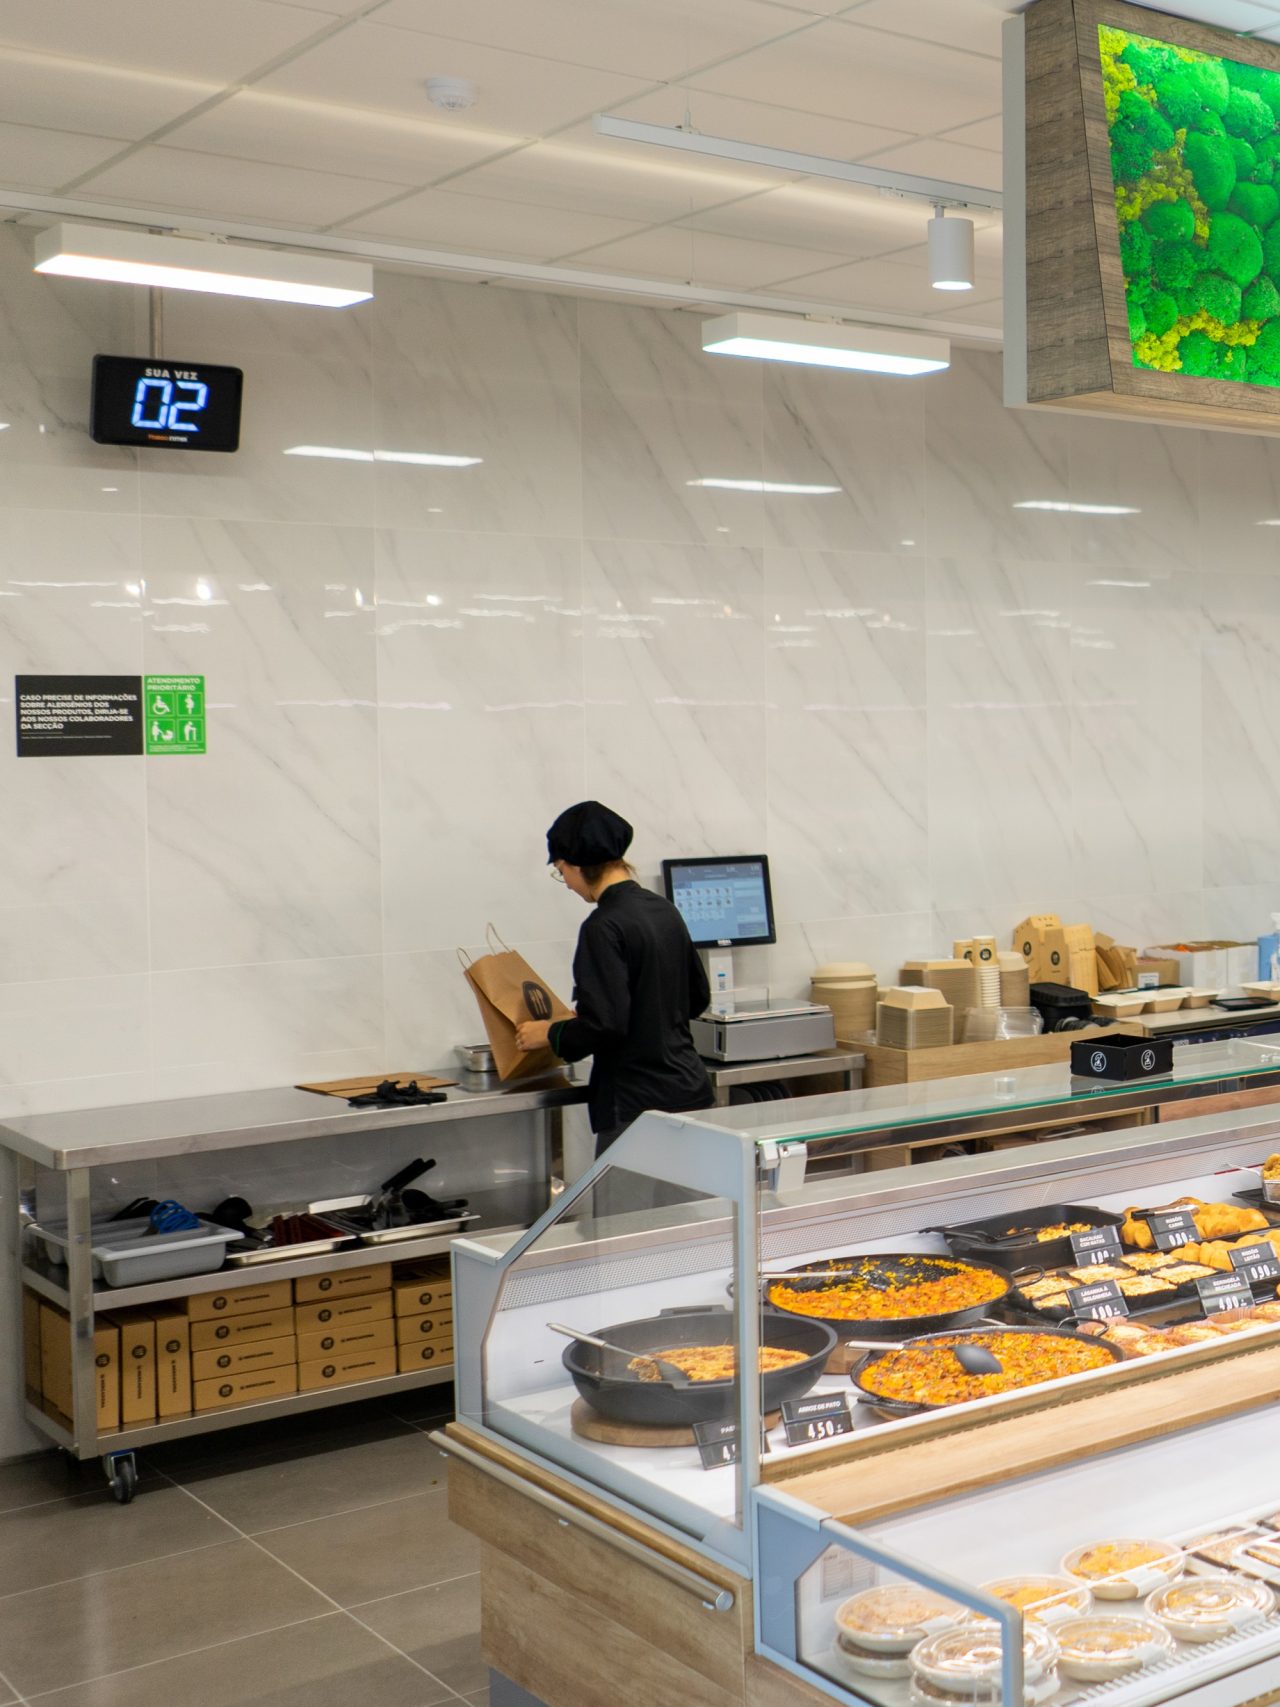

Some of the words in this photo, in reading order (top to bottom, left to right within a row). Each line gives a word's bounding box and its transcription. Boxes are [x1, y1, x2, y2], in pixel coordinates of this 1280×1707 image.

[145, 368, 170, 378] SUA
[174, 370, 198, 381] VEZ
[131, 377, 209, 432] 02
